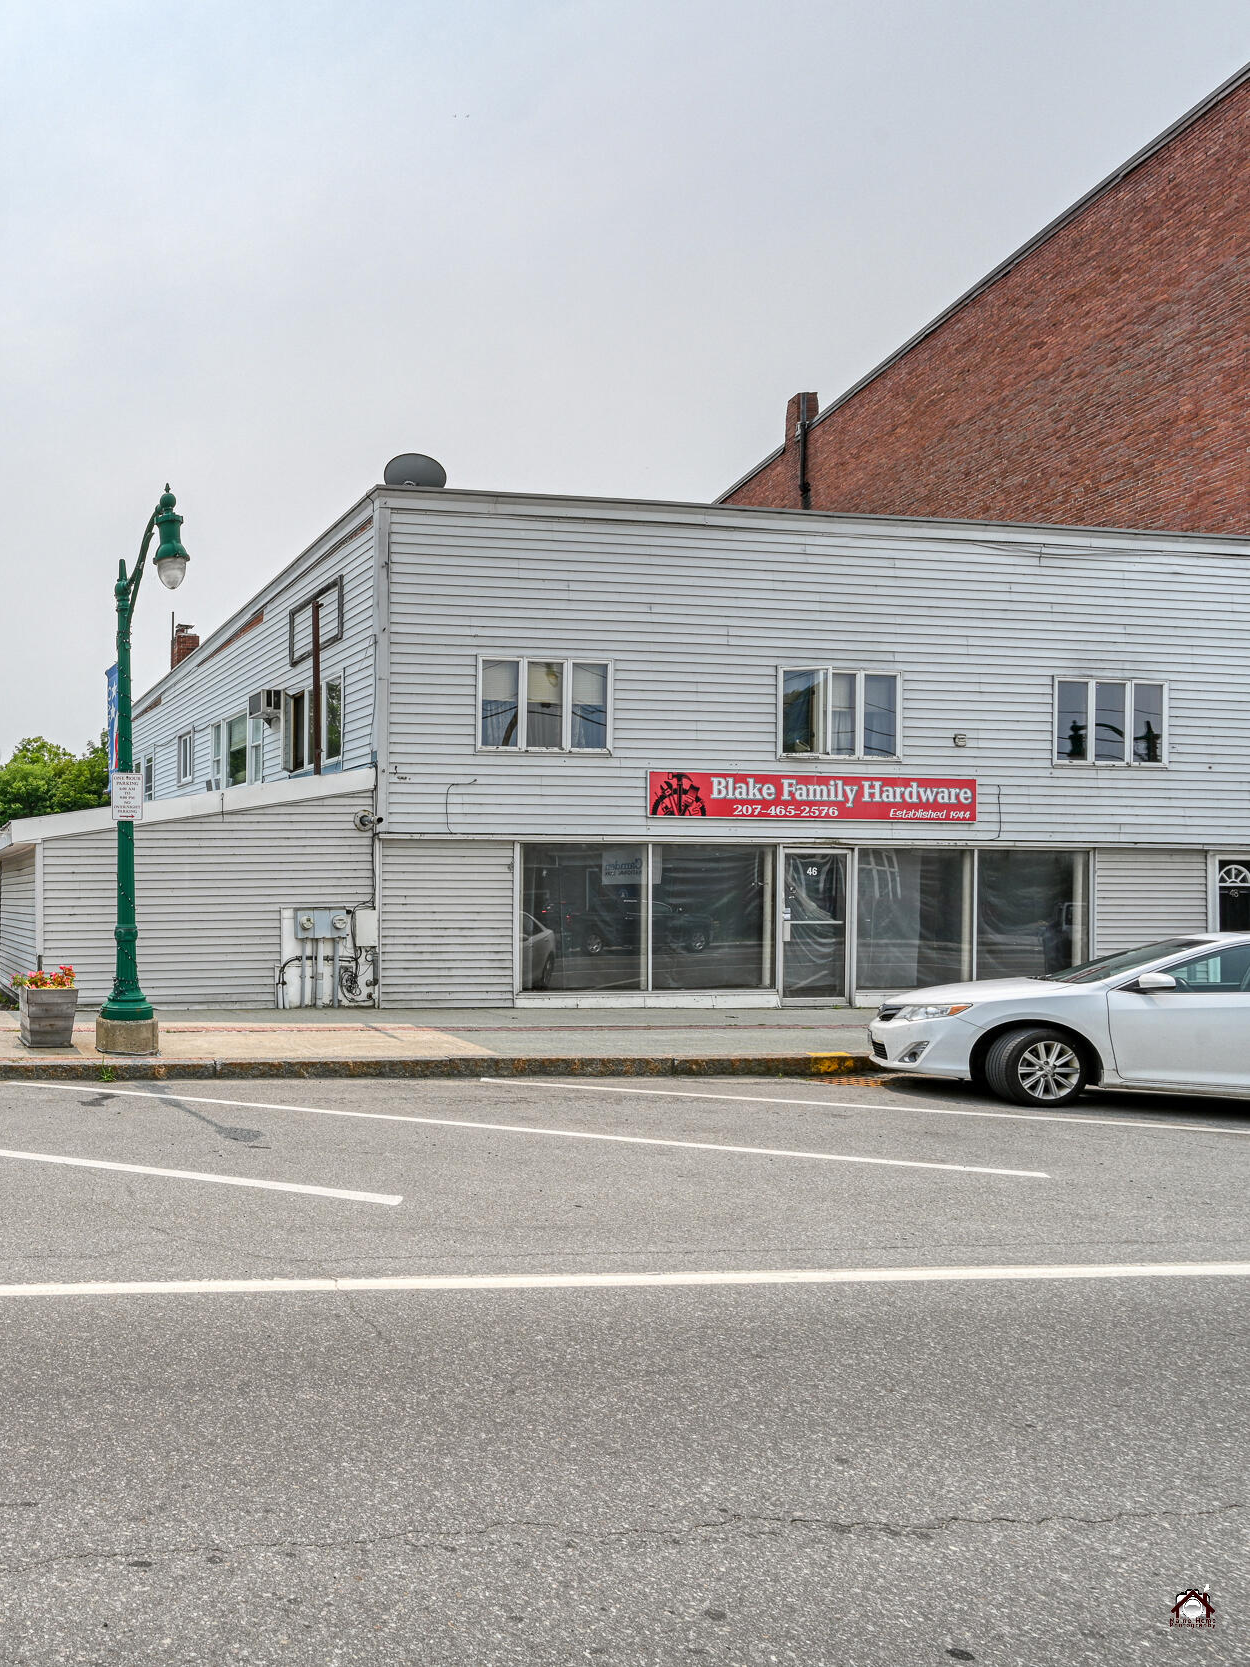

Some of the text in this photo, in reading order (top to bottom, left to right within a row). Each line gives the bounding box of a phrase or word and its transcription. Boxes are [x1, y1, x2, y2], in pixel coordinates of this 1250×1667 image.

[710, 776, 973, 807] Blake Family Hardware
[732, 804, 839, 817] 207-465-2576
[889, 808, 971, 819] Established 1944
[806, 866, 818, 876] 46
